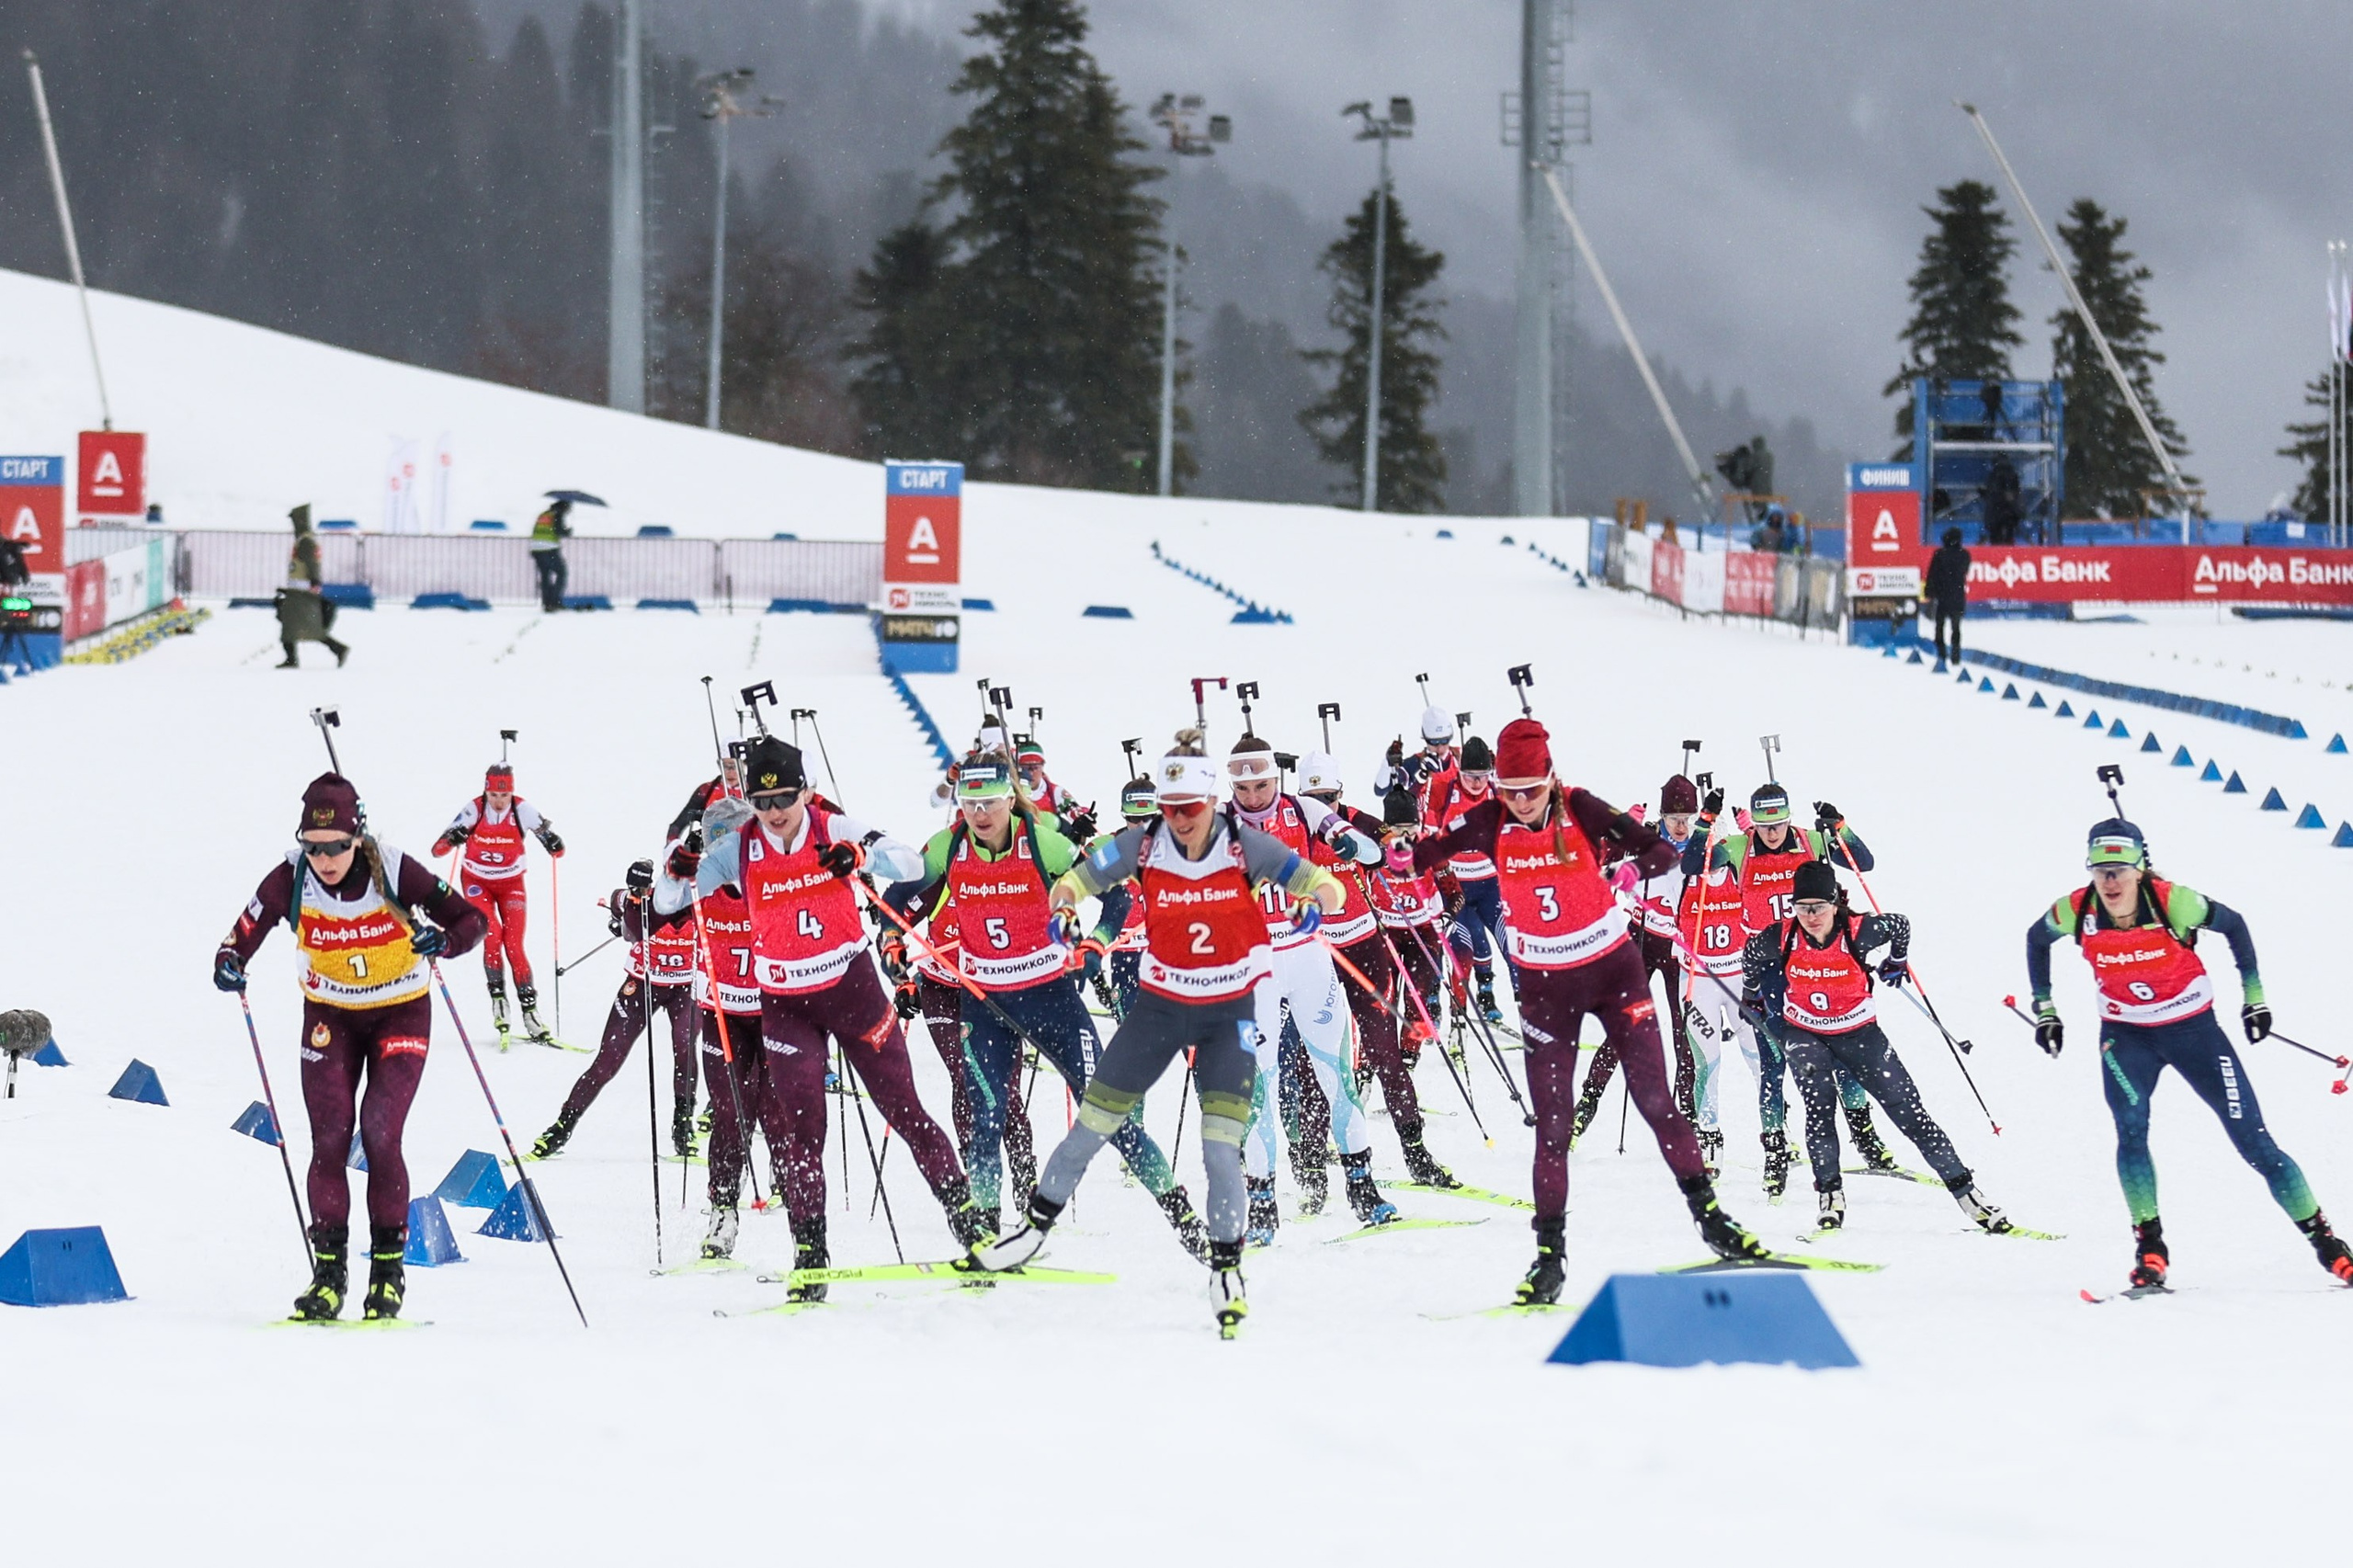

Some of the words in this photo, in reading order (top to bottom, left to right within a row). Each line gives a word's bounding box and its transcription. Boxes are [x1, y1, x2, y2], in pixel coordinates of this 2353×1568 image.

[3, 460, 49, 479] СТАРТ
[93, 449, 124, 484] А
[1859, 468, 1910, 486] ФИНИШ
[899, 470, 948, 489] СТАРТ
[11, 505, 42, 541] А
[906, 516, 939, 551] А
[1872, 509, 1900, 540] А
[1966, 556, 2037, 588] льфа
[2042, 556, 2111, 582] Банк
[2193, 554, 2284, 589] Альфа
[480, 850, 505, 864] 25
[1506, 855, 1545, 869] Альфа
[762, 880, 803, 893] Альфа
[1753, 871, 1783, 882] Альфа
[960, 882, 997, 897] Альфа
[998, 882, 1029, 894] Банк
[1157, 889, 1201, 905] Альфа
[1203, 888, 1239, 902] Банк
[1260, 882, 1288, 914] 11
[1535, 886, 1560, 922] 3
[1691, 902, 1721, 914] Аьфа
[1722, 902, 1743, 911] Банк
[1768, 893, 1795, 922] 15
[312, 927, 358, 943] Альфа
[359, 922, 394, 937] Банк
[706, 917, 741, 932] Альфа
[797, 909, 825, 940] 4
[985, 918, 1010, 950] 5
[649, 935, 677, 947] Альфа
[1188, 922, 1216, 955] 2
[1527, 928, 1608, 954] ТЕХНОНИКОЛЬ
[1702, 924, 1730, 949] 18
[348, 954, 368, 979] 1
[731, 948, 751, 977] 7
[978, 952, 1059, 975] ТЕХНОНИКОЛЬ
[2096, 952, 2135, 966] Альфа
[2135, 949, 2166, 962] Банк
[1790, 965, 1822, 979] Альфа
[1823, 968, 1848, 977] Банк
[1809, 992, 1831, 1012] 9
[2128, 981, 2155, 1002] 6
